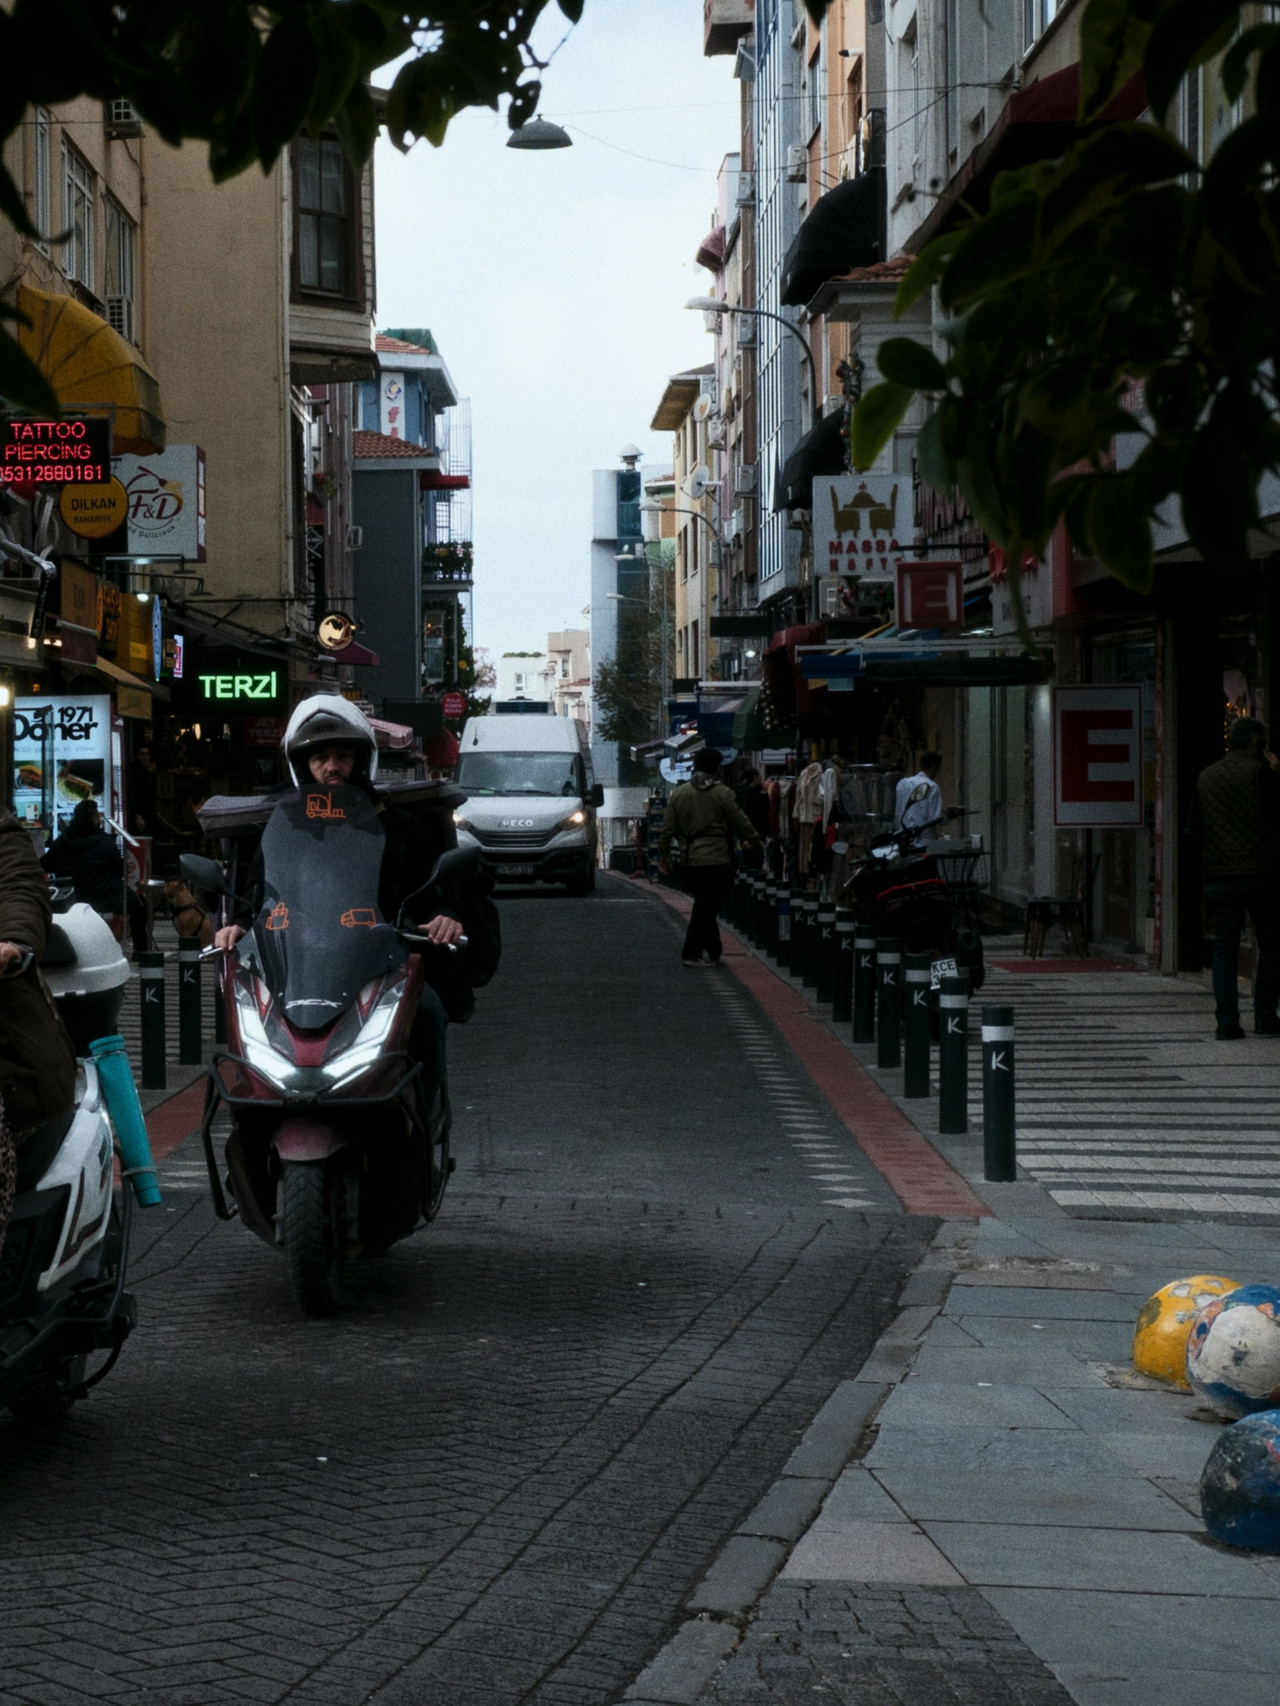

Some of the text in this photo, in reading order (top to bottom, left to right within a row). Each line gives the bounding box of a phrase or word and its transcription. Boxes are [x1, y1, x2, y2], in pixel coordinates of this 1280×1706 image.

[10, 421, 87, 439] TATTOO
[829, 539, 900, 555] MASSA
[198, 671, 278, 698] TERZİ
[58, 706, 94, 722] 1971
[1061, 710, 1135, 802] E
[860, 954, 873, 968] K
[931, 960, 955, 973] KCE
[183, 968, 197, 984] K
[883, 970, 897, 986] K
[145, 987, 160, 1004] K
[913, 989, 928, 1007] K
[947, 1016, 964, 1034] K
[991, 1050, 1010, 1071] K
